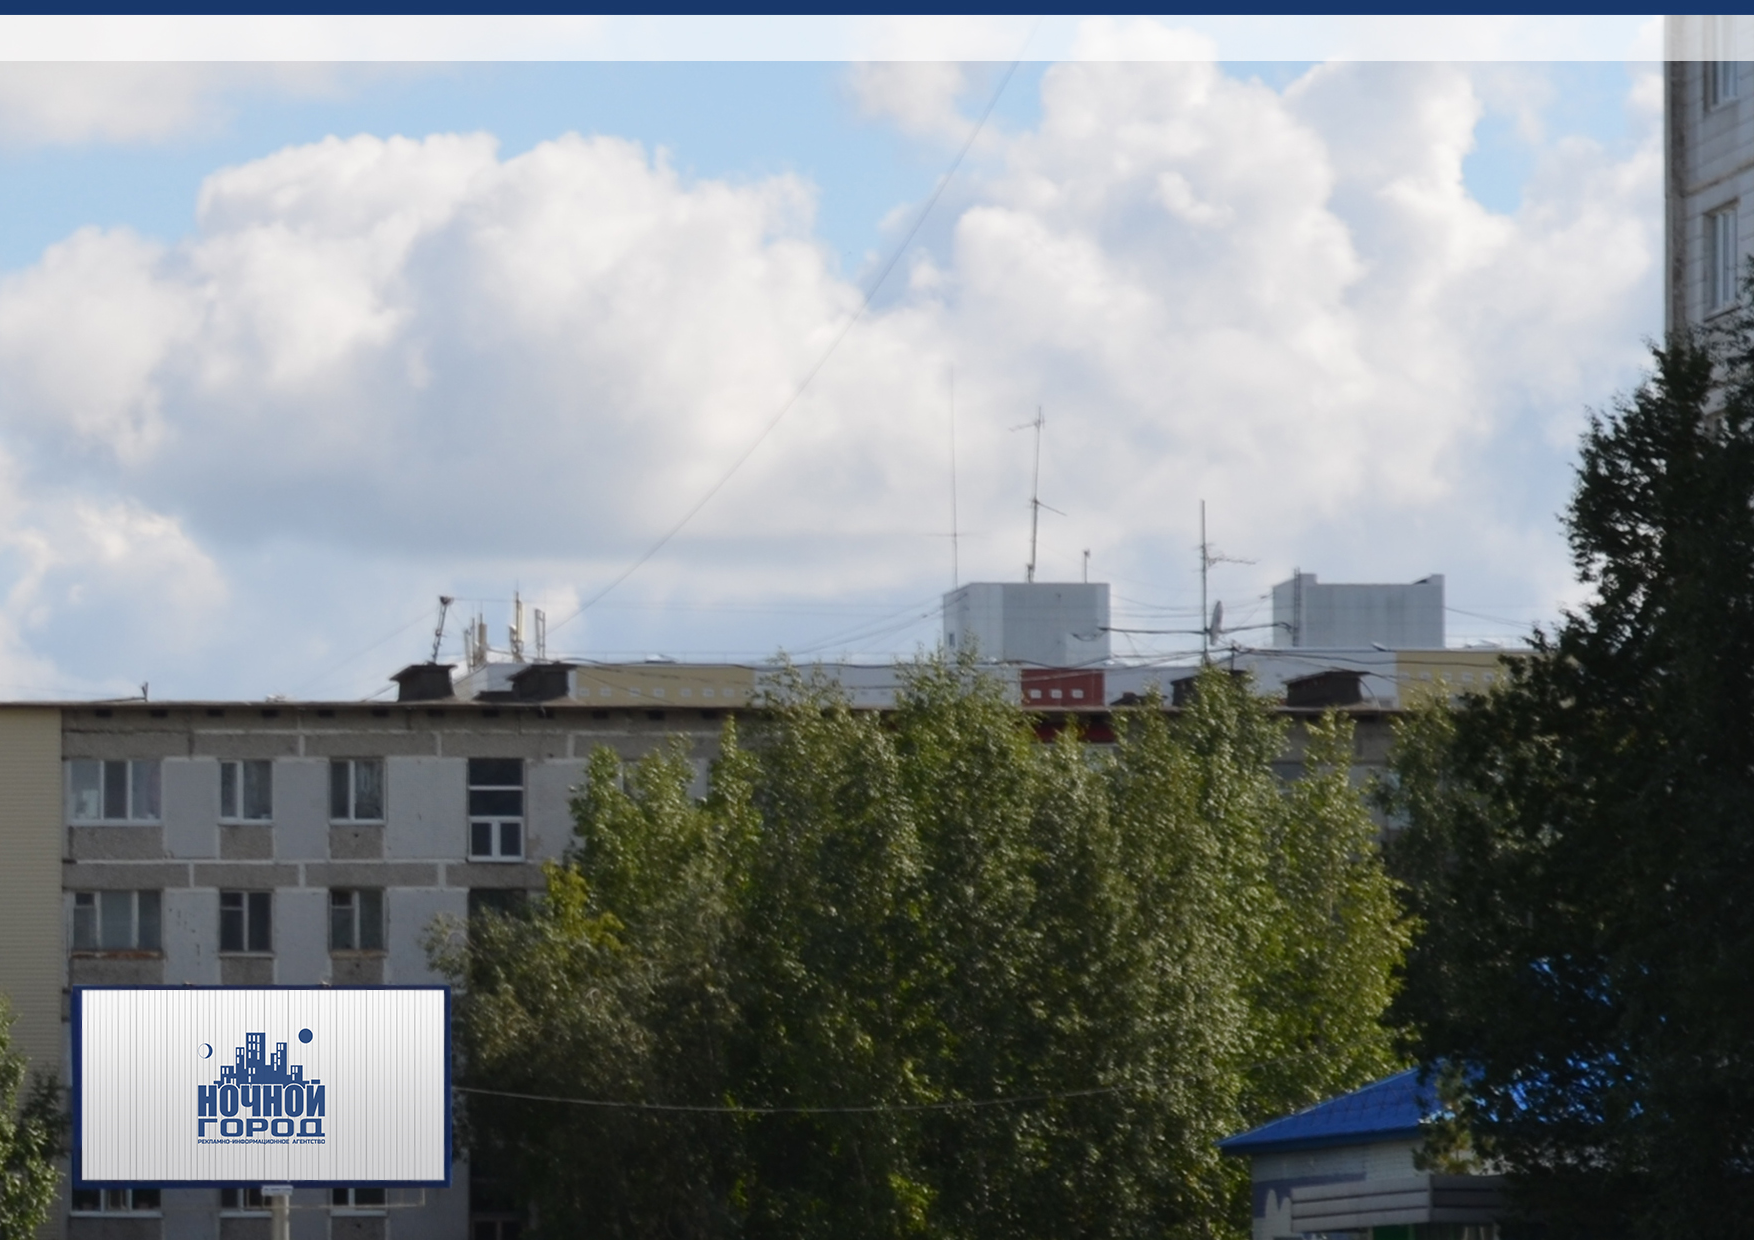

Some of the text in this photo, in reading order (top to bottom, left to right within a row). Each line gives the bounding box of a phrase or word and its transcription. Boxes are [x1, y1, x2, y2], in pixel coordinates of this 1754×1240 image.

[198, 1079, 326, 1118] НОЧНОЙ
[198, 1118, 326, 1138] ГОРОД
[197, 1138, 290, 1146] РЕКЛАМНО-ИНФОРМАЦИОННОЕ
